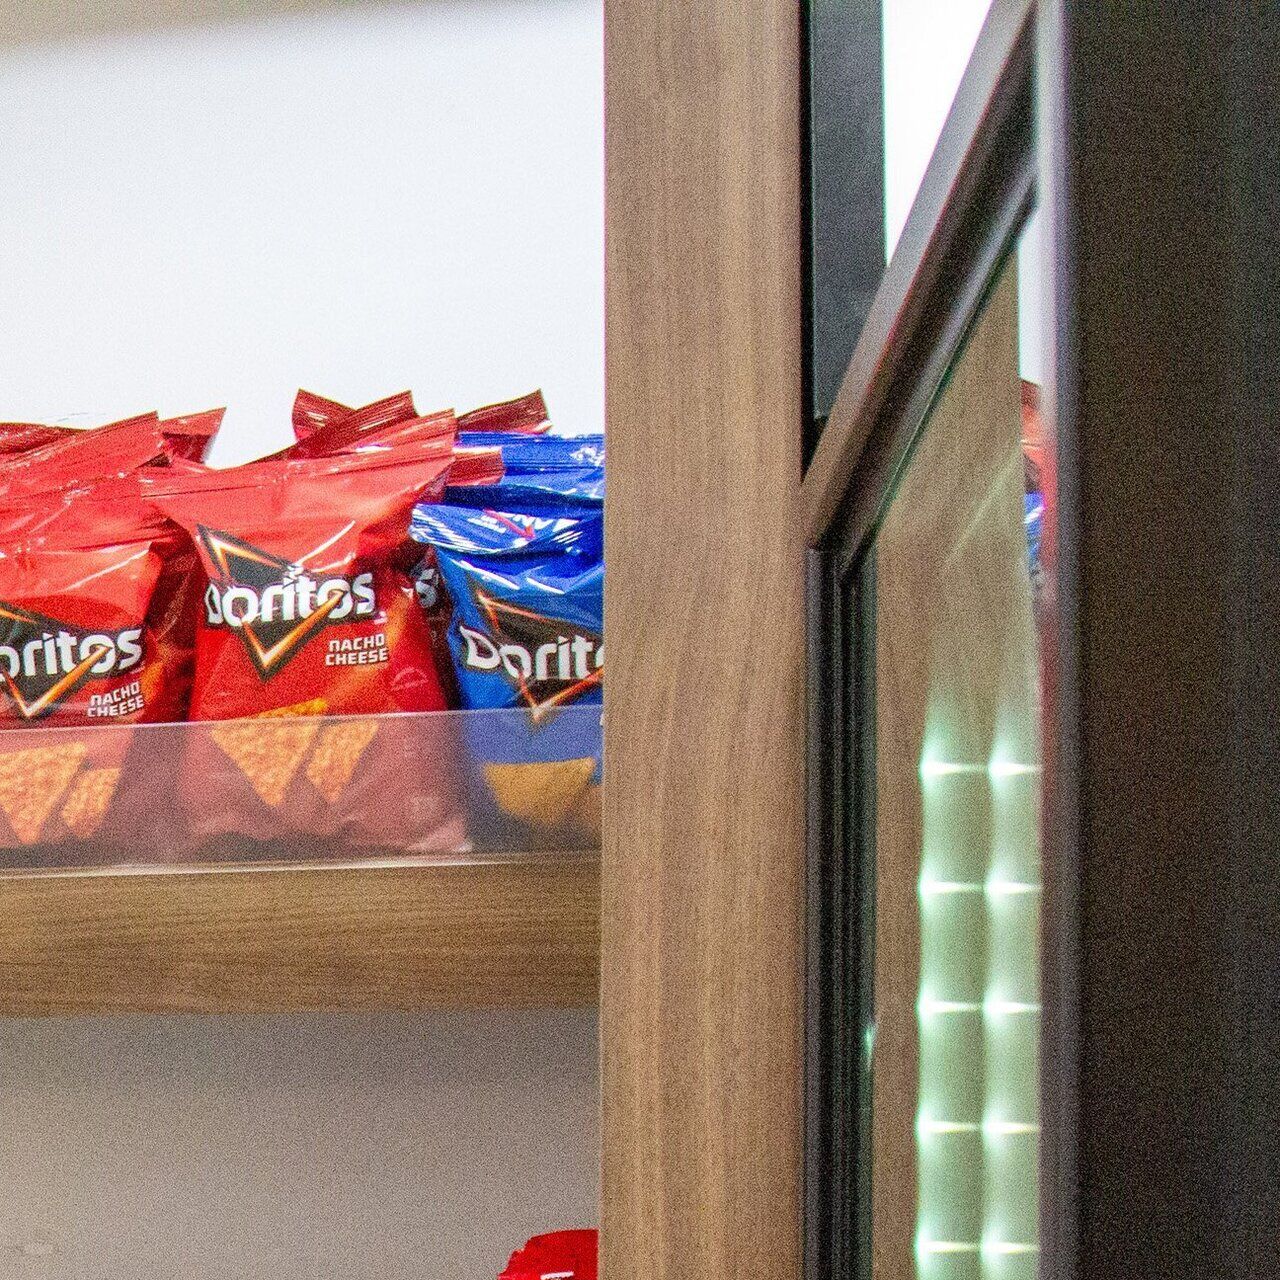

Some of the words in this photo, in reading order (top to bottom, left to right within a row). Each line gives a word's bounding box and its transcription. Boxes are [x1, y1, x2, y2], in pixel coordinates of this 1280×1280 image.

[203, 565, 376, 630] Doritos
[328, 634, 386, 654] NACHO
[325, 647, 389, 667] CHEESE
[88, 682, 142, 704] NACHO
[87, 694, 145, 719] CHEESE
